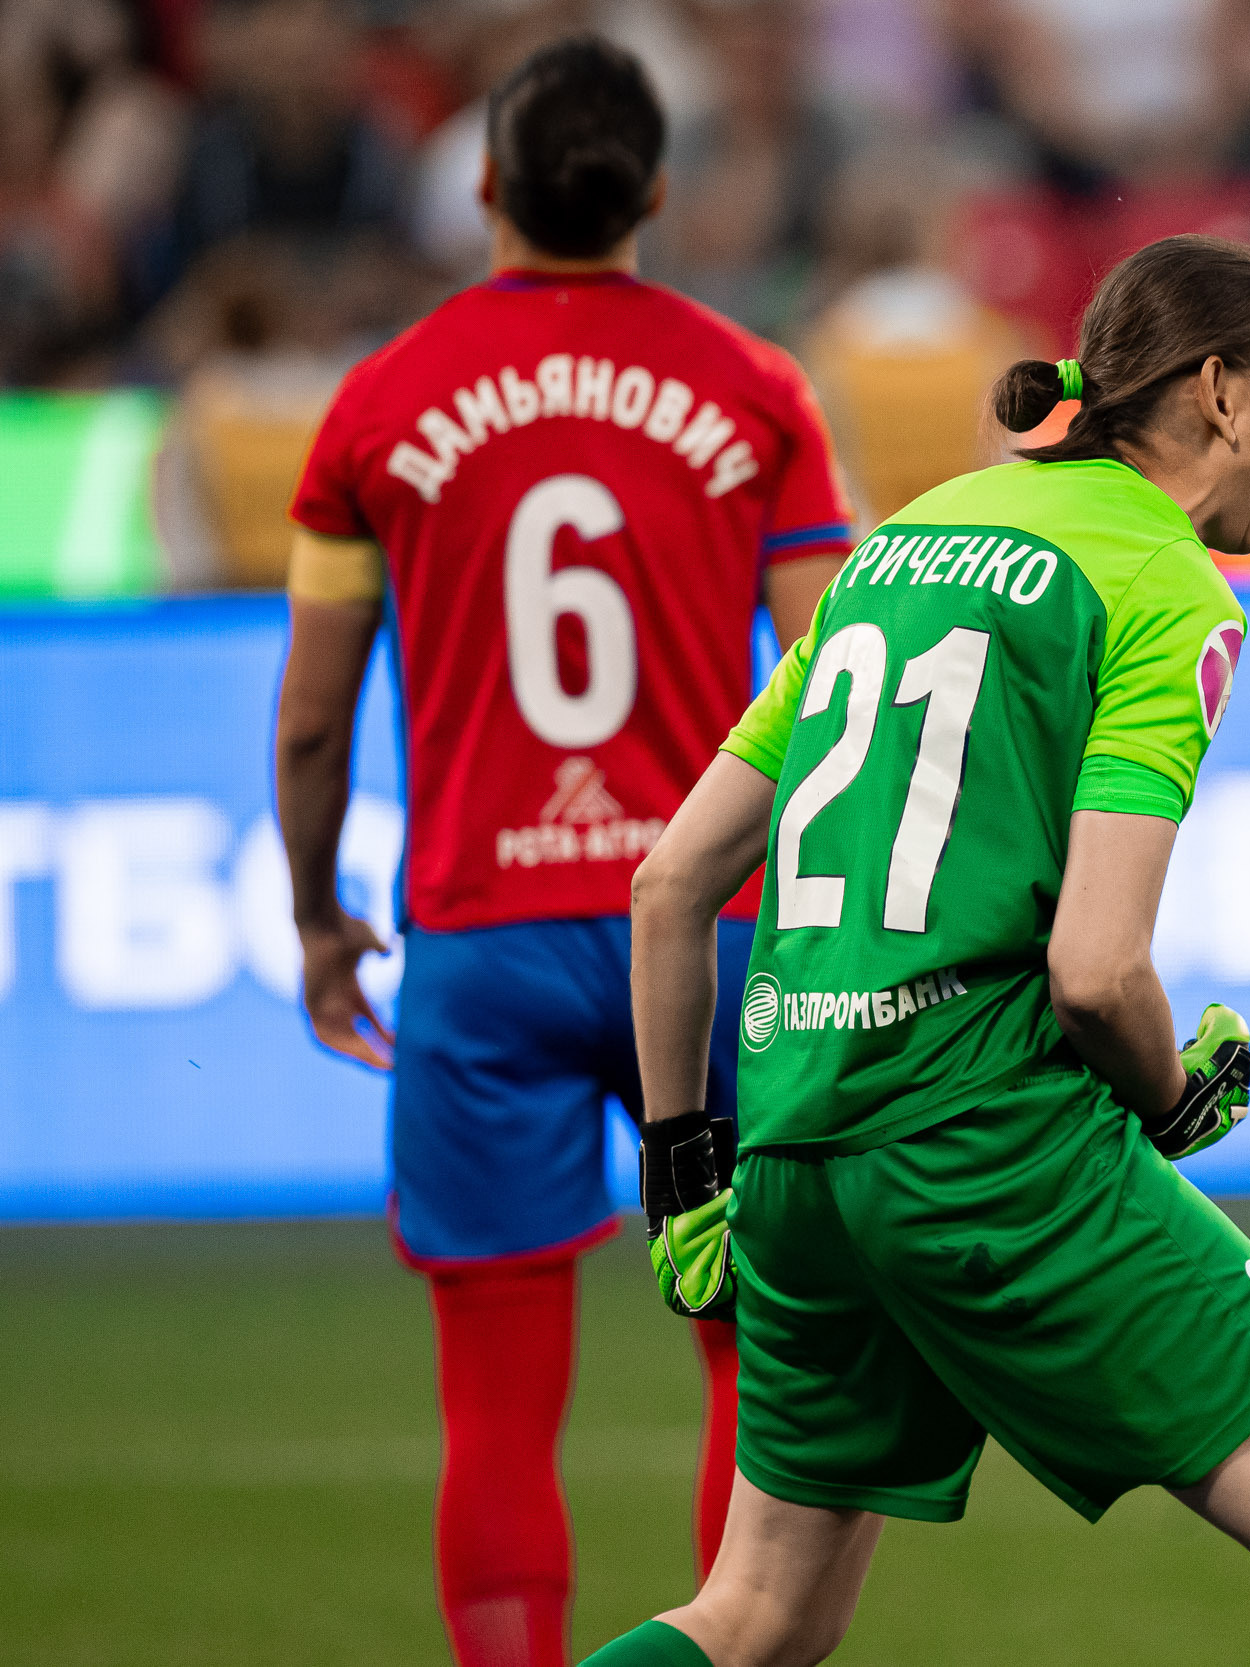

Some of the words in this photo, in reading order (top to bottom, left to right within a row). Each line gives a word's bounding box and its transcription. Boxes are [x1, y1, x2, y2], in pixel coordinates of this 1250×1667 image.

[387, 353, 759, 503] ДАМЬЯНОВИЧ
[503, 472, 640, 749] 6
[830, 535, 1058, 605] ГРИЧЕНКО
[776, 622, 991, 934] 21
[783, 967, 967, 1031] ГАЗПРОМБАНК
